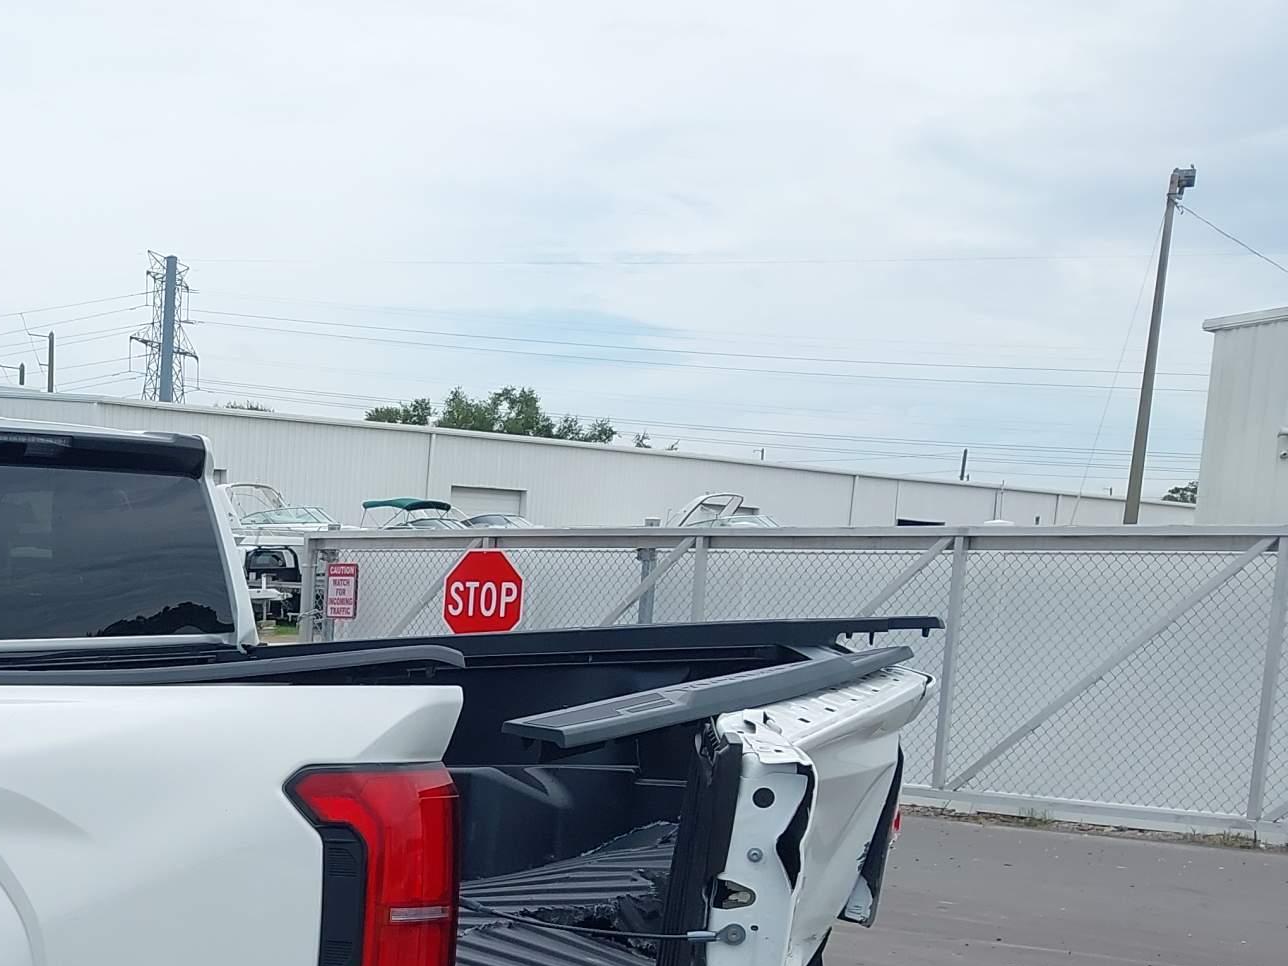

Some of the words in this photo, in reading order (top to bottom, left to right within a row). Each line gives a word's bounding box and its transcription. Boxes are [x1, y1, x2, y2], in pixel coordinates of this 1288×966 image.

[329, 565, 356, 575] CAUTION
[332, 578, 351, 587] WATCH
[335, 588, 346, 597] FOR
[328, 597, 353, 606] INCOMING
[447, 581, 518, 618] STOP
[329, 606, 351, 616] TRAFFIC
